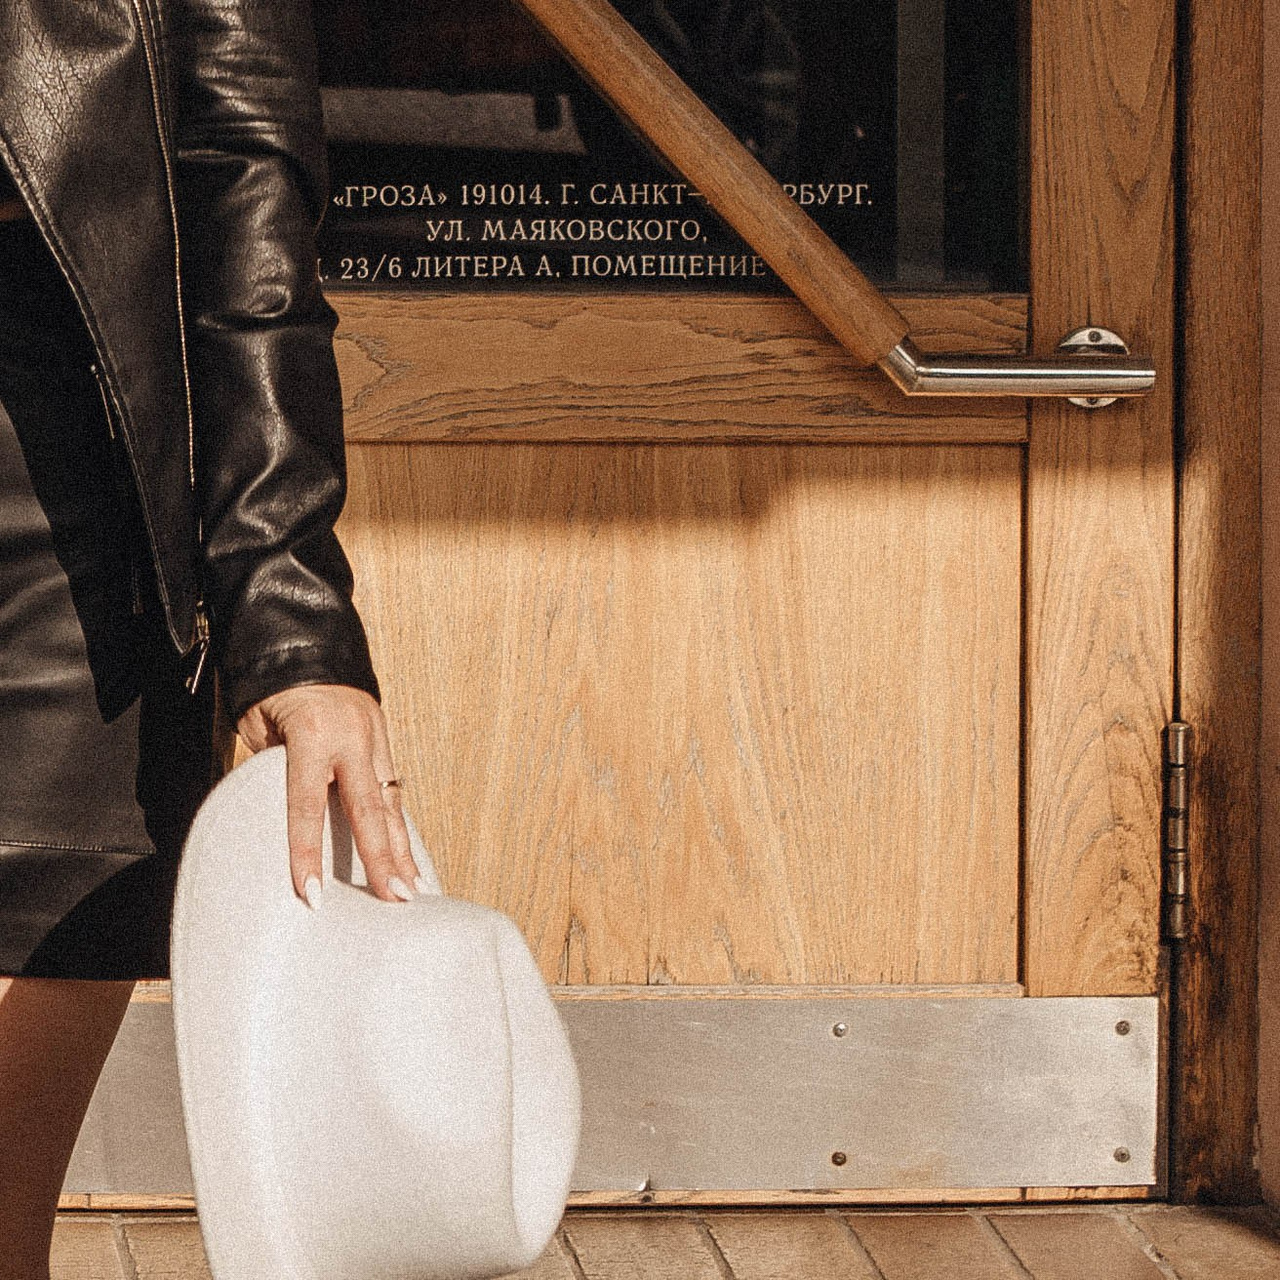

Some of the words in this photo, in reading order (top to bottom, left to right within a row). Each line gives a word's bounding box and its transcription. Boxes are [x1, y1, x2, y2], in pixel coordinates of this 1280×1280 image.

[333, 184, 447, 207] «ГРОЗА»
[462, 184, 550, 206] 191014.
[561, 183, 579, 206] Г.
[425, 219, 471, 242] УЛ.
[481, 218, 707, 243] МАЯКОВСКОГО,
[340, 254, 402, 282] 23/6
[411, 255, 525, 278] ЛИТЕРА
[535, 255, 560, 278] А,
[572, 255, 766, 280] ПОМЕЩЕНИЕ
